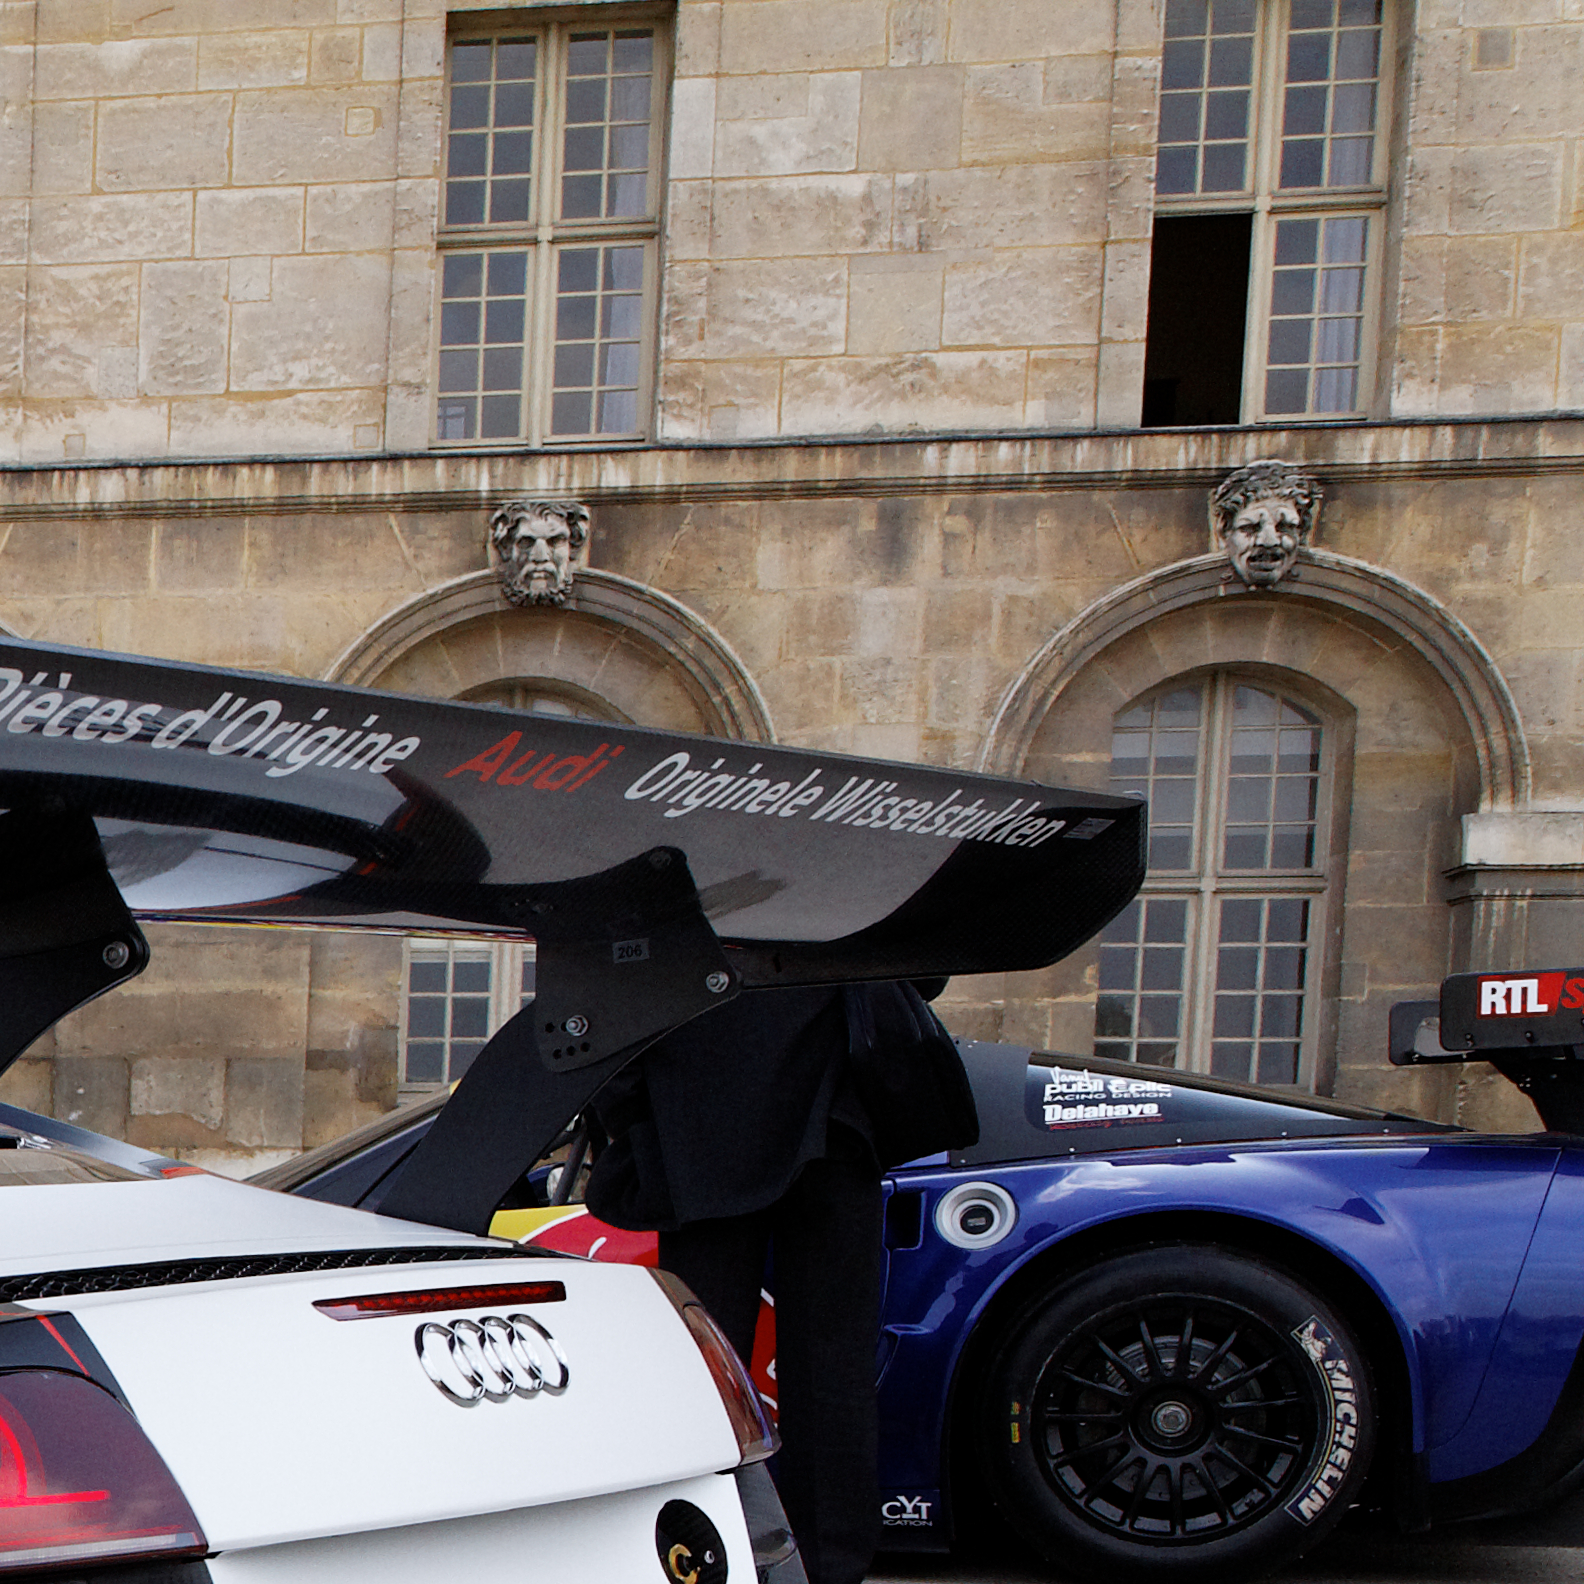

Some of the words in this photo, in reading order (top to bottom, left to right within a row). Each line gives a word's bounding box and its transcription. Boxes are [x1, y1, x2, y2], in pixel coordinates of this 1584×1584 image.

[151, 691, 421, 778] d'Origine
[443, 729, 625, 793] Audi
[623, 751, 825, 819] Originele
[807, 775, 1069, 848] Wisselstukken
[618, 944, 643, 960] 206
[1481, 978, 1549, 1015] RTL
[1043, 1103, 1160, 1122] Delahaye
[1297, 1359, 1359, 1521] MICHELIN
